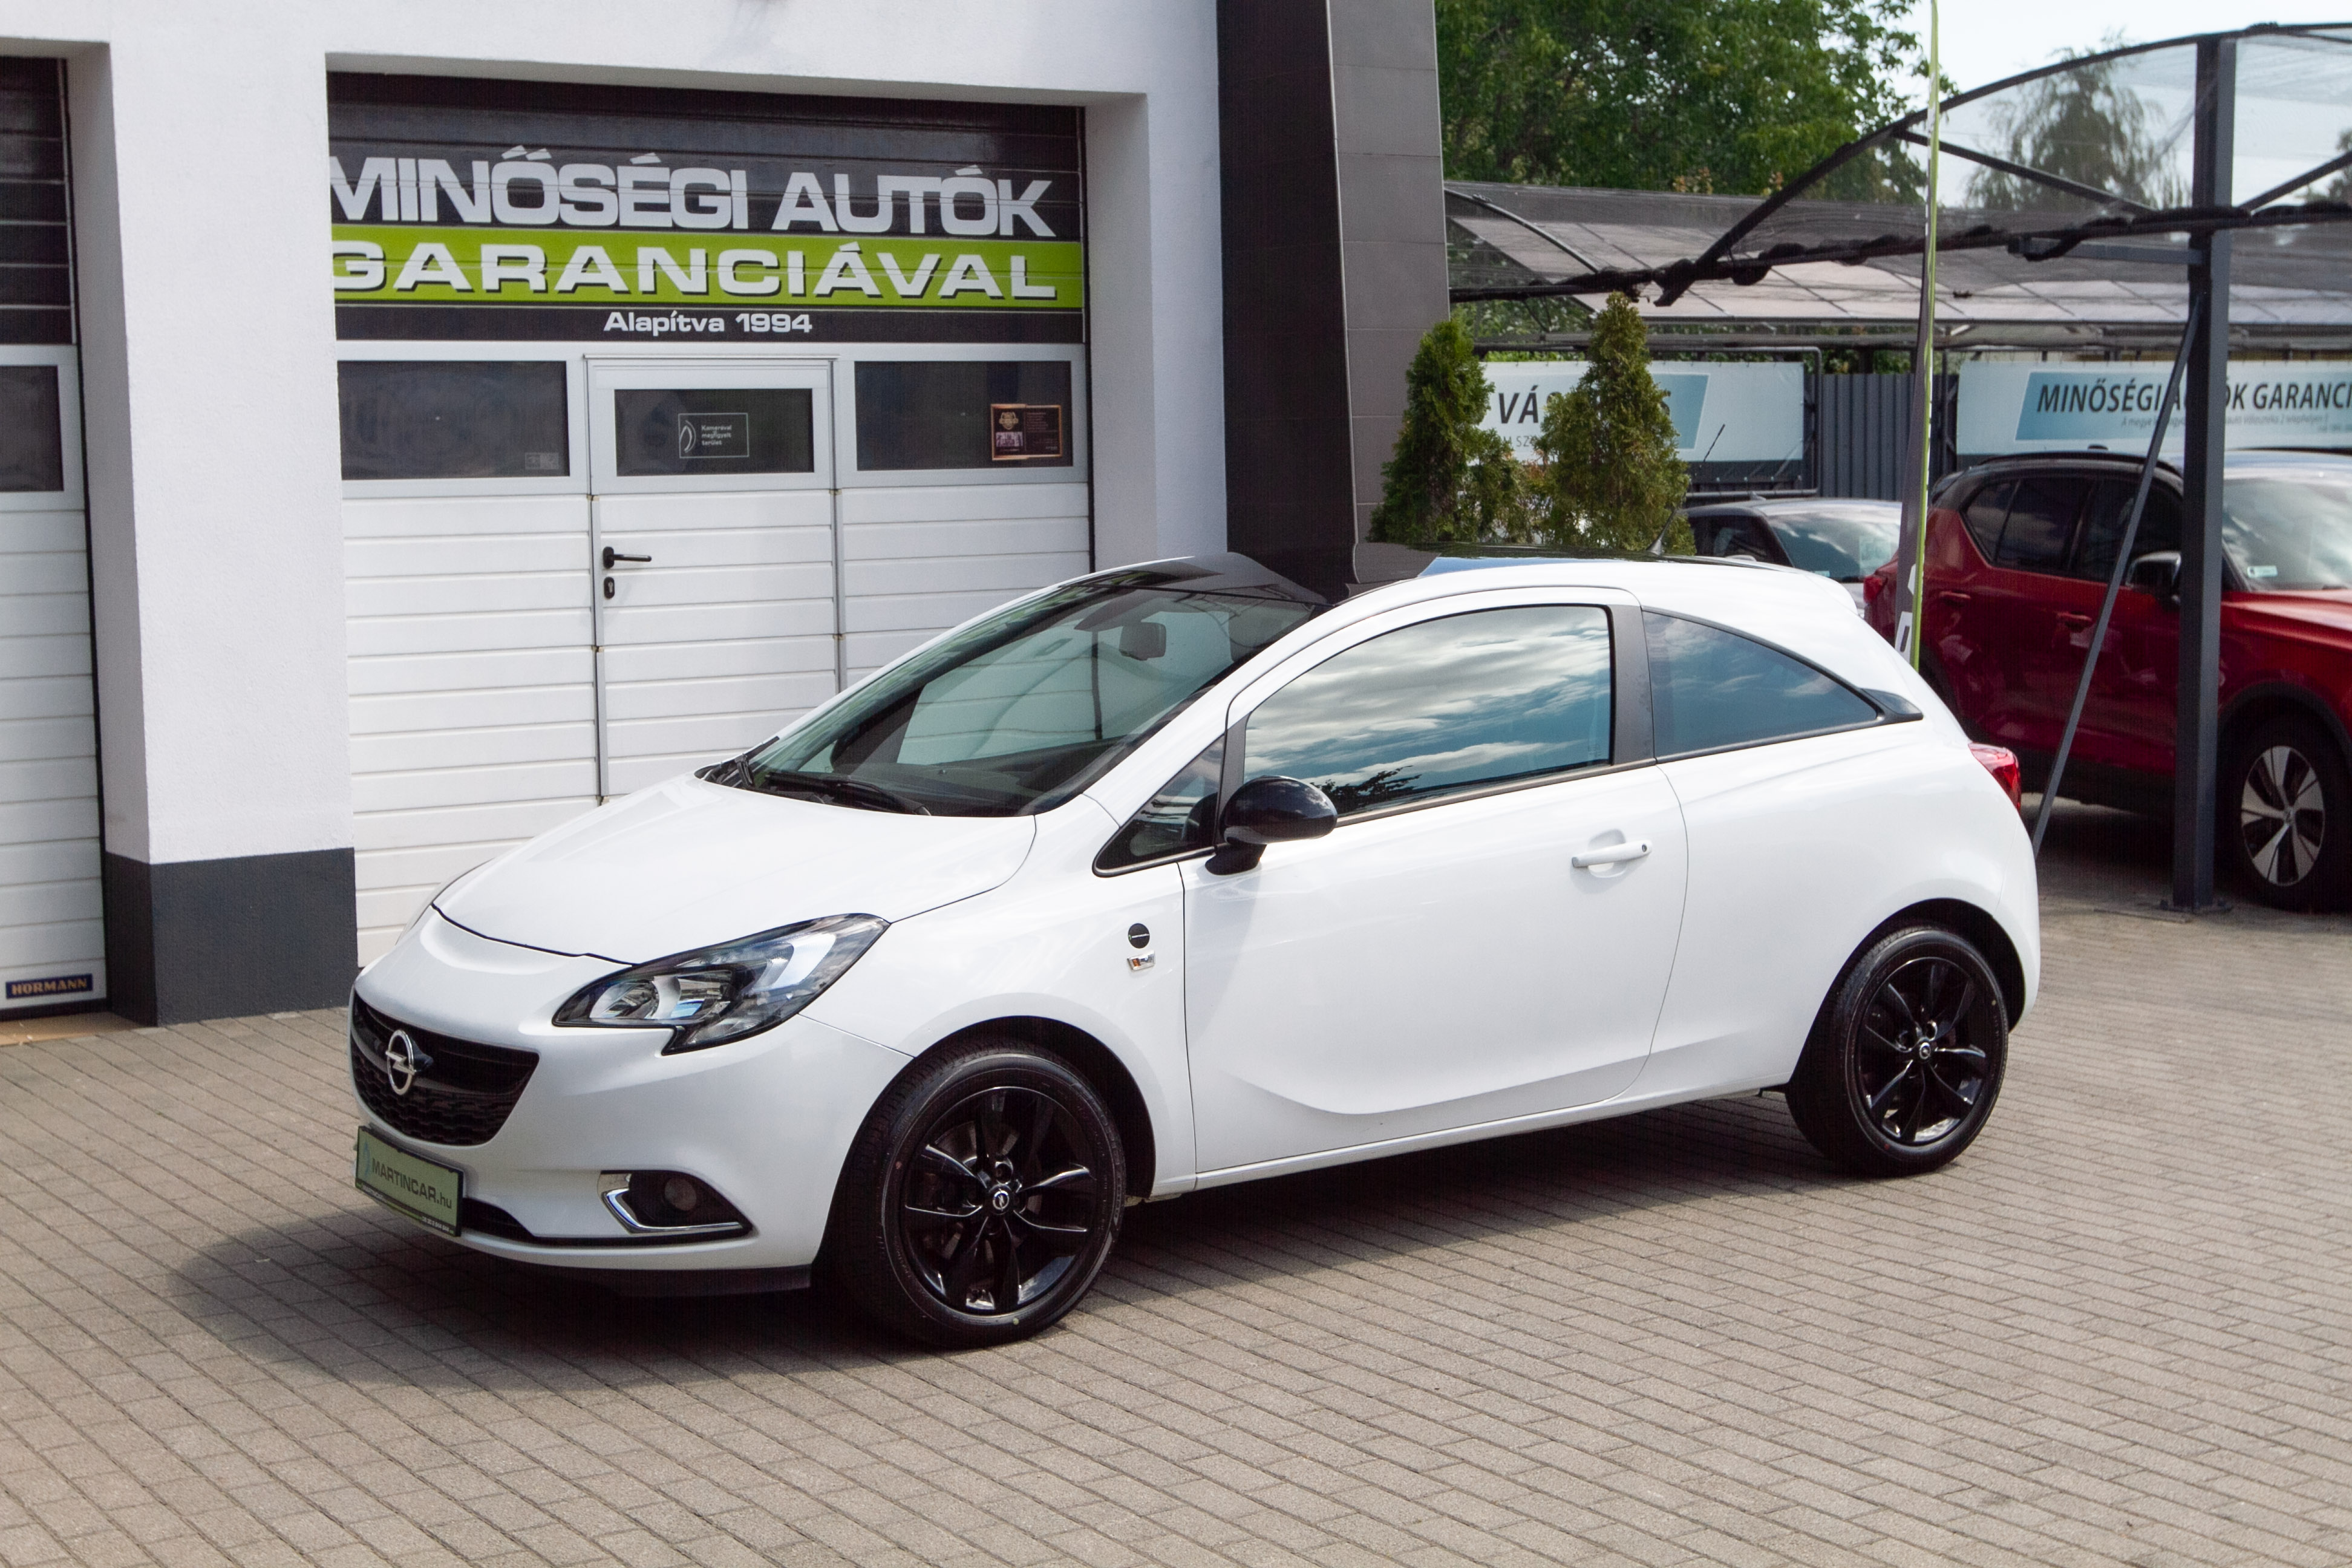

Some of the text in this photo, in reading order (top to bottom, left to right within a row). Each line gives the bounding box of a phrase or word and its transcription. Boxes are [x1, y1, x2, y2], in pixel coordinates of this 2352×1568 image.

[330, 145, 1056, 237] MINŐSÉGI AUTÓK
[332, 240, 1057, 299] GARANCIÁVAL
[604, 310, 812, 336] Alapítva 1994
[2037, 378, 2162, 413] MINŐSÉGI
[372, 1158, 452, 1209] MARTINCAR.hu
